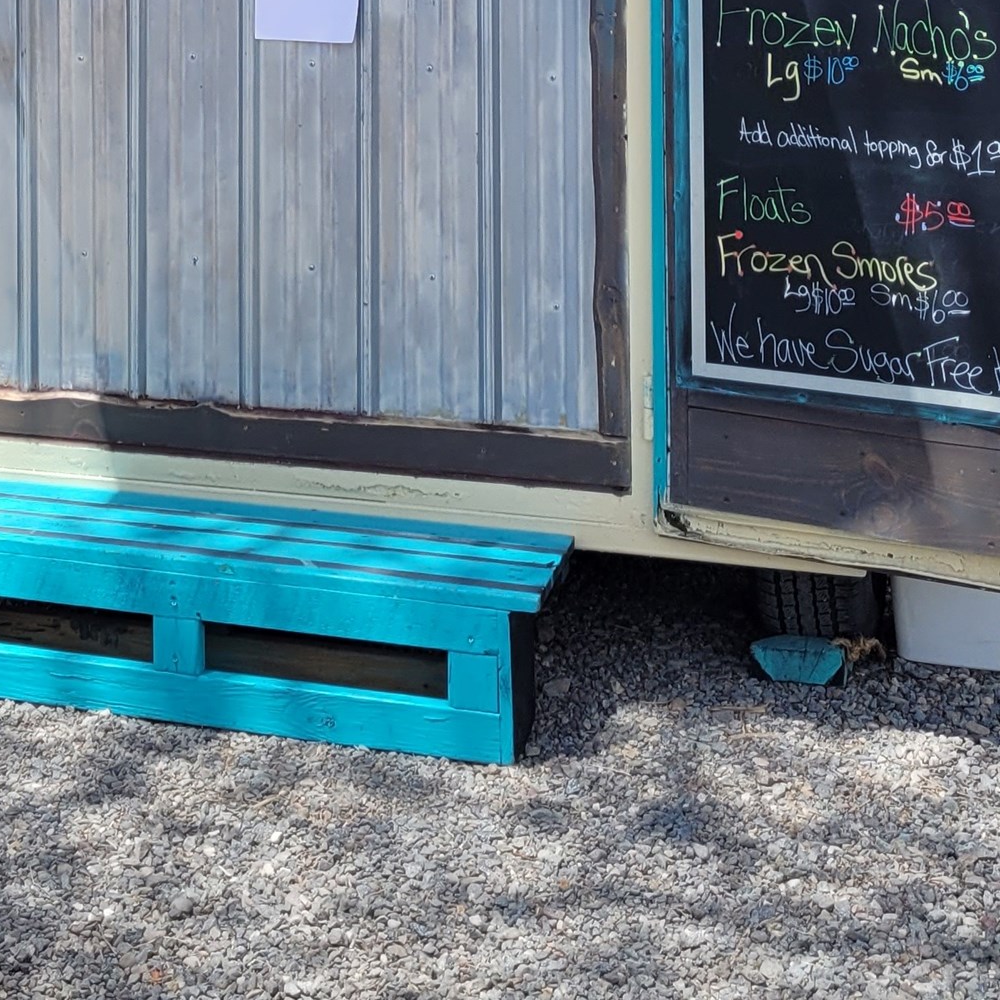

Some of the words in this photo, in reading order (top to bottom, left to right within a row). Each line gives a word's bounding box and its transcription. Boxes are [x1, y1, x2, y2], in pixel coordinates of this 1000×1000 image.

[767, 53, 800, 102] Lg
[740, 117, 773, 147] Add
[777, 122, 858, 154] additional
[926, 140, 947, 167] for
[717, 175, 811, 224] Floats
[717, 230, 837, 290] Frozen
[832, 241, 937, 292] Smores
[784, 275, 812, 313] Lg
[710, 303, 754, 364] We
[757, 317, 829, 369] have
[825, 328, 922, 384] Sugar
[923, 336, 993, 395] Free
